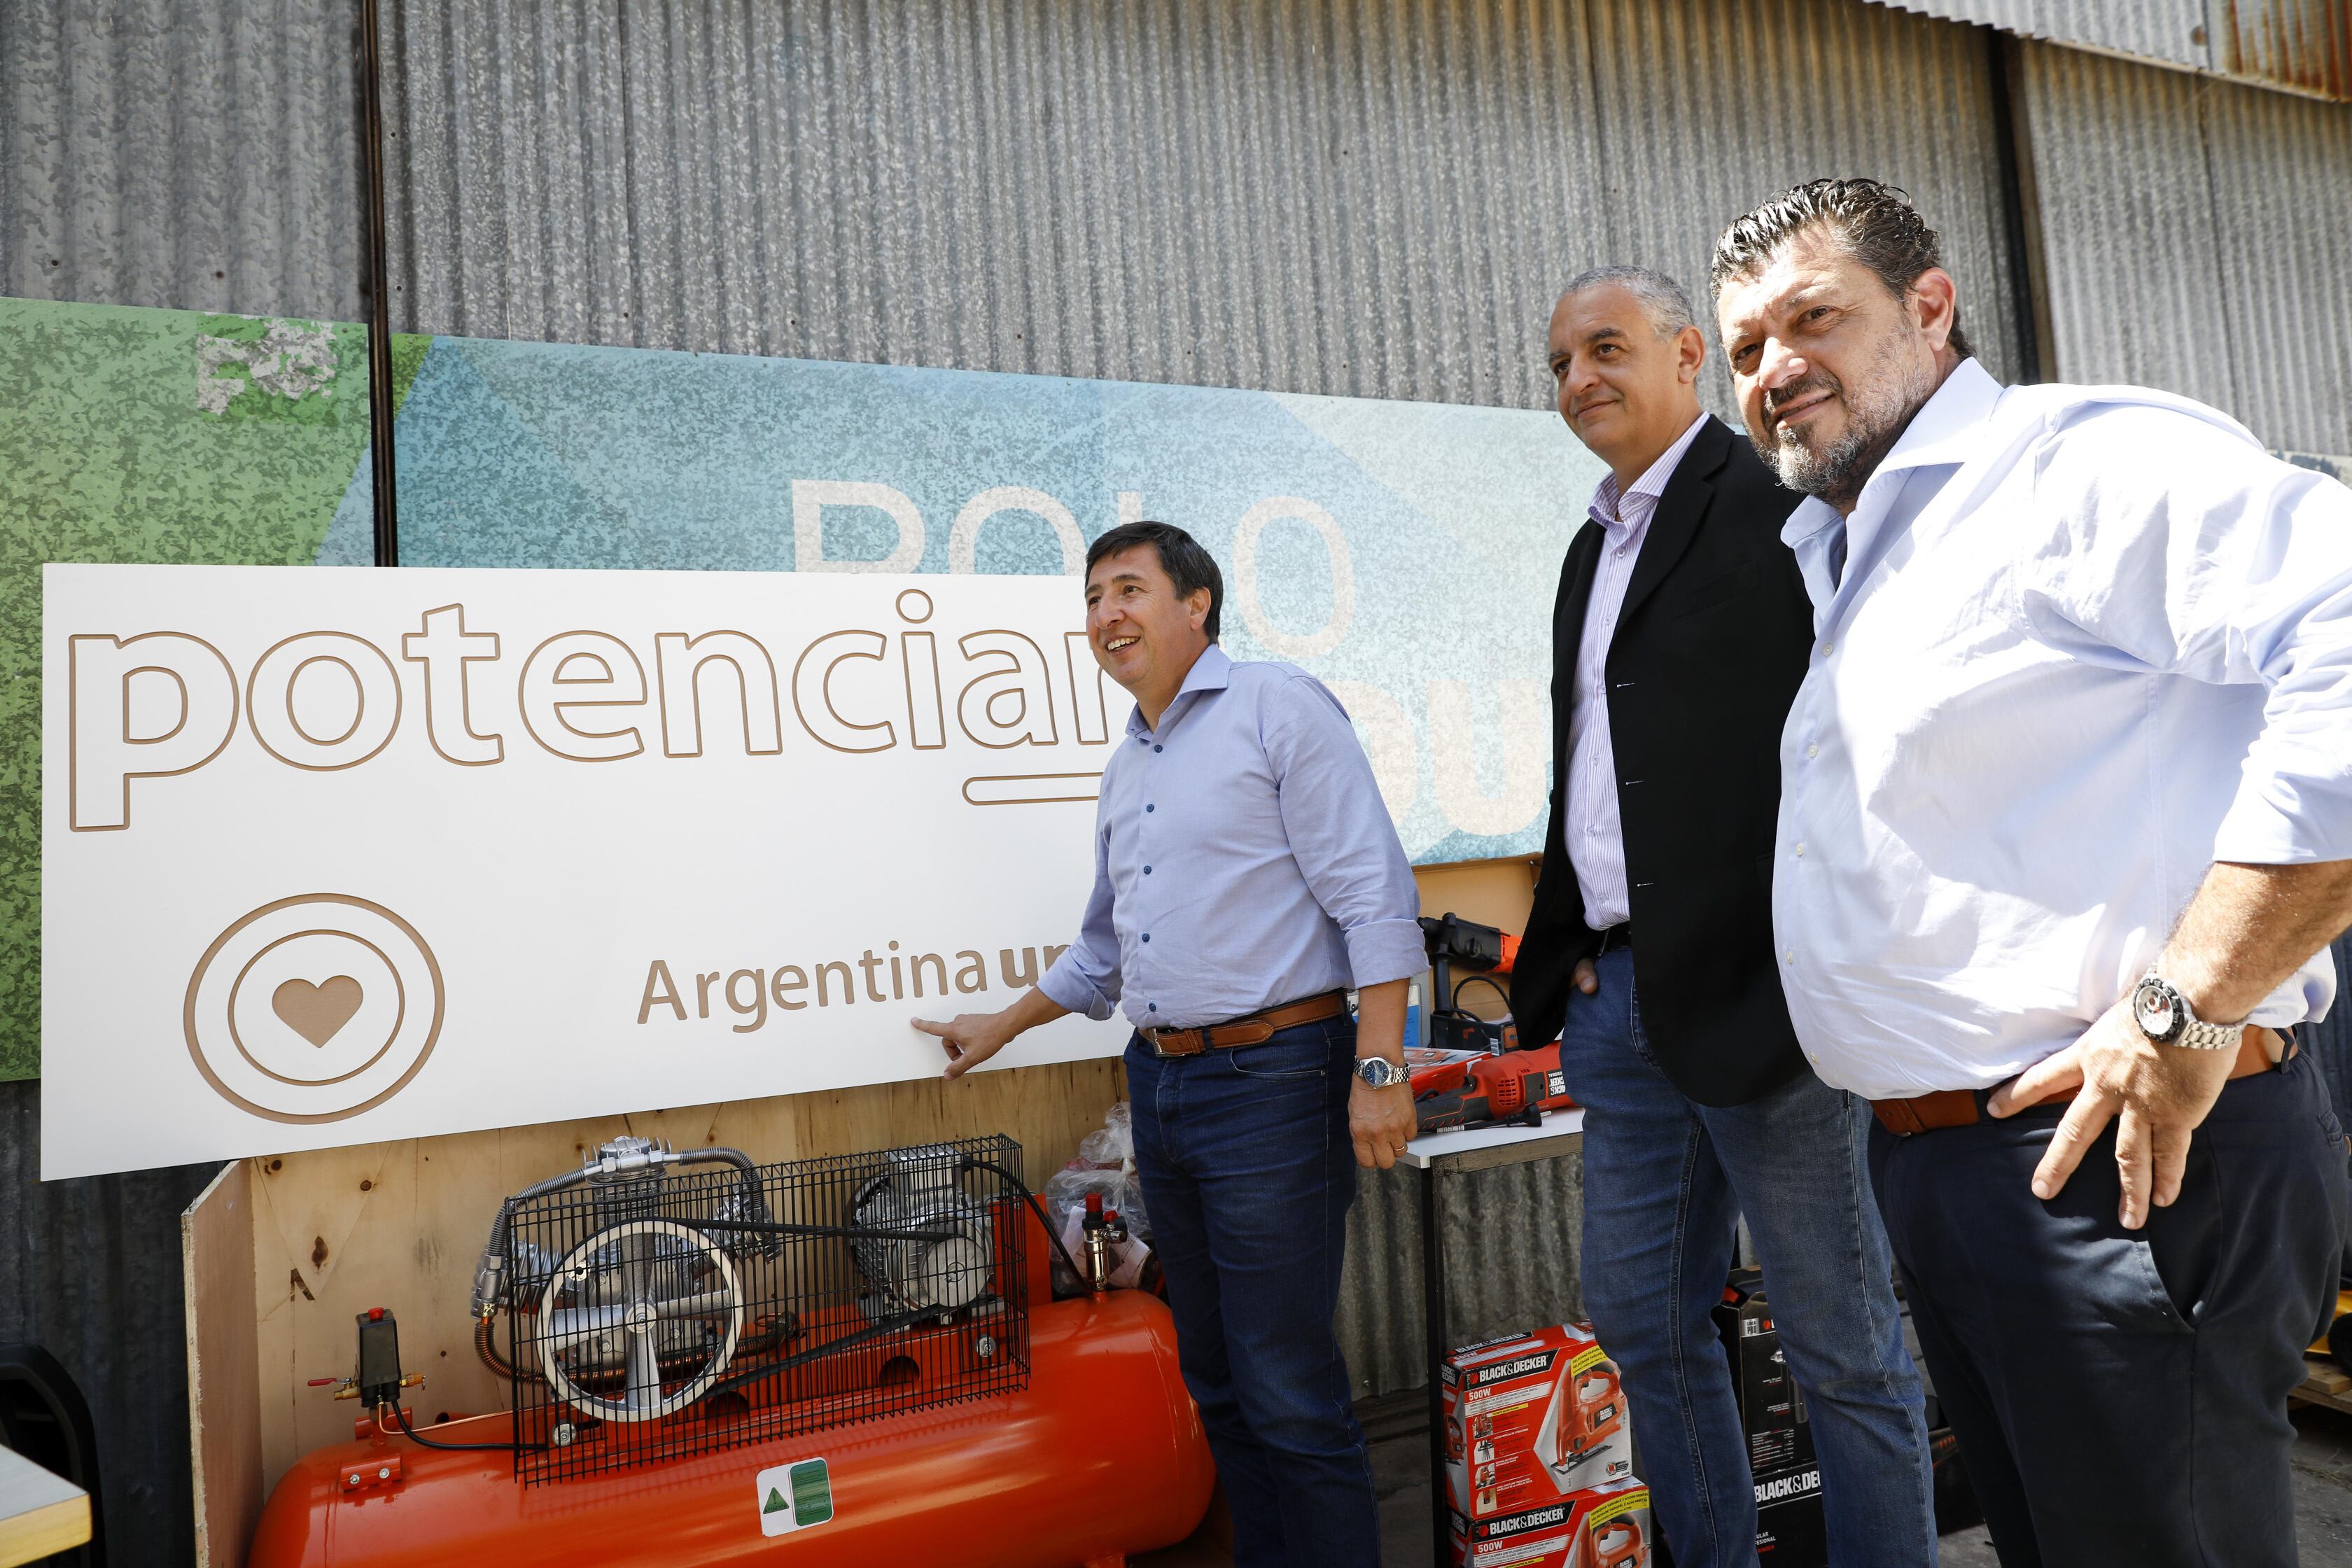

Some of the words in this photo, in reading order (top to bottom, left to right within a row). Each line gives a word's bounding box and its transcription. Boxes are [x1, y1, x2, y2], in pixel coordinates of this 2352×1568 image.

[791, 479, 1354, 657] POO
[638, 941, 988, 1034] Argentina
[1549, 1076, 1564, 1087] CKER
[1550, 1085, 1566, 1096] ACK&
[1455, 1332, 1526, 1353] BLACK&DECKER
[1441, 1364, 1455, 1378] LACK&
[1479, 1355, 1547, 1382] BLACK&DECKER
[1441, 1371, 1456, 1385] ECKER
[1469, 1387, 1492, 1401] 500W
[1754, 1470, 1821, 1503] BLACK&DE
[1490, 1508, 1564, 1535] BLACK&DECKER
[1478, 1541, 1503, 1553] 500W
